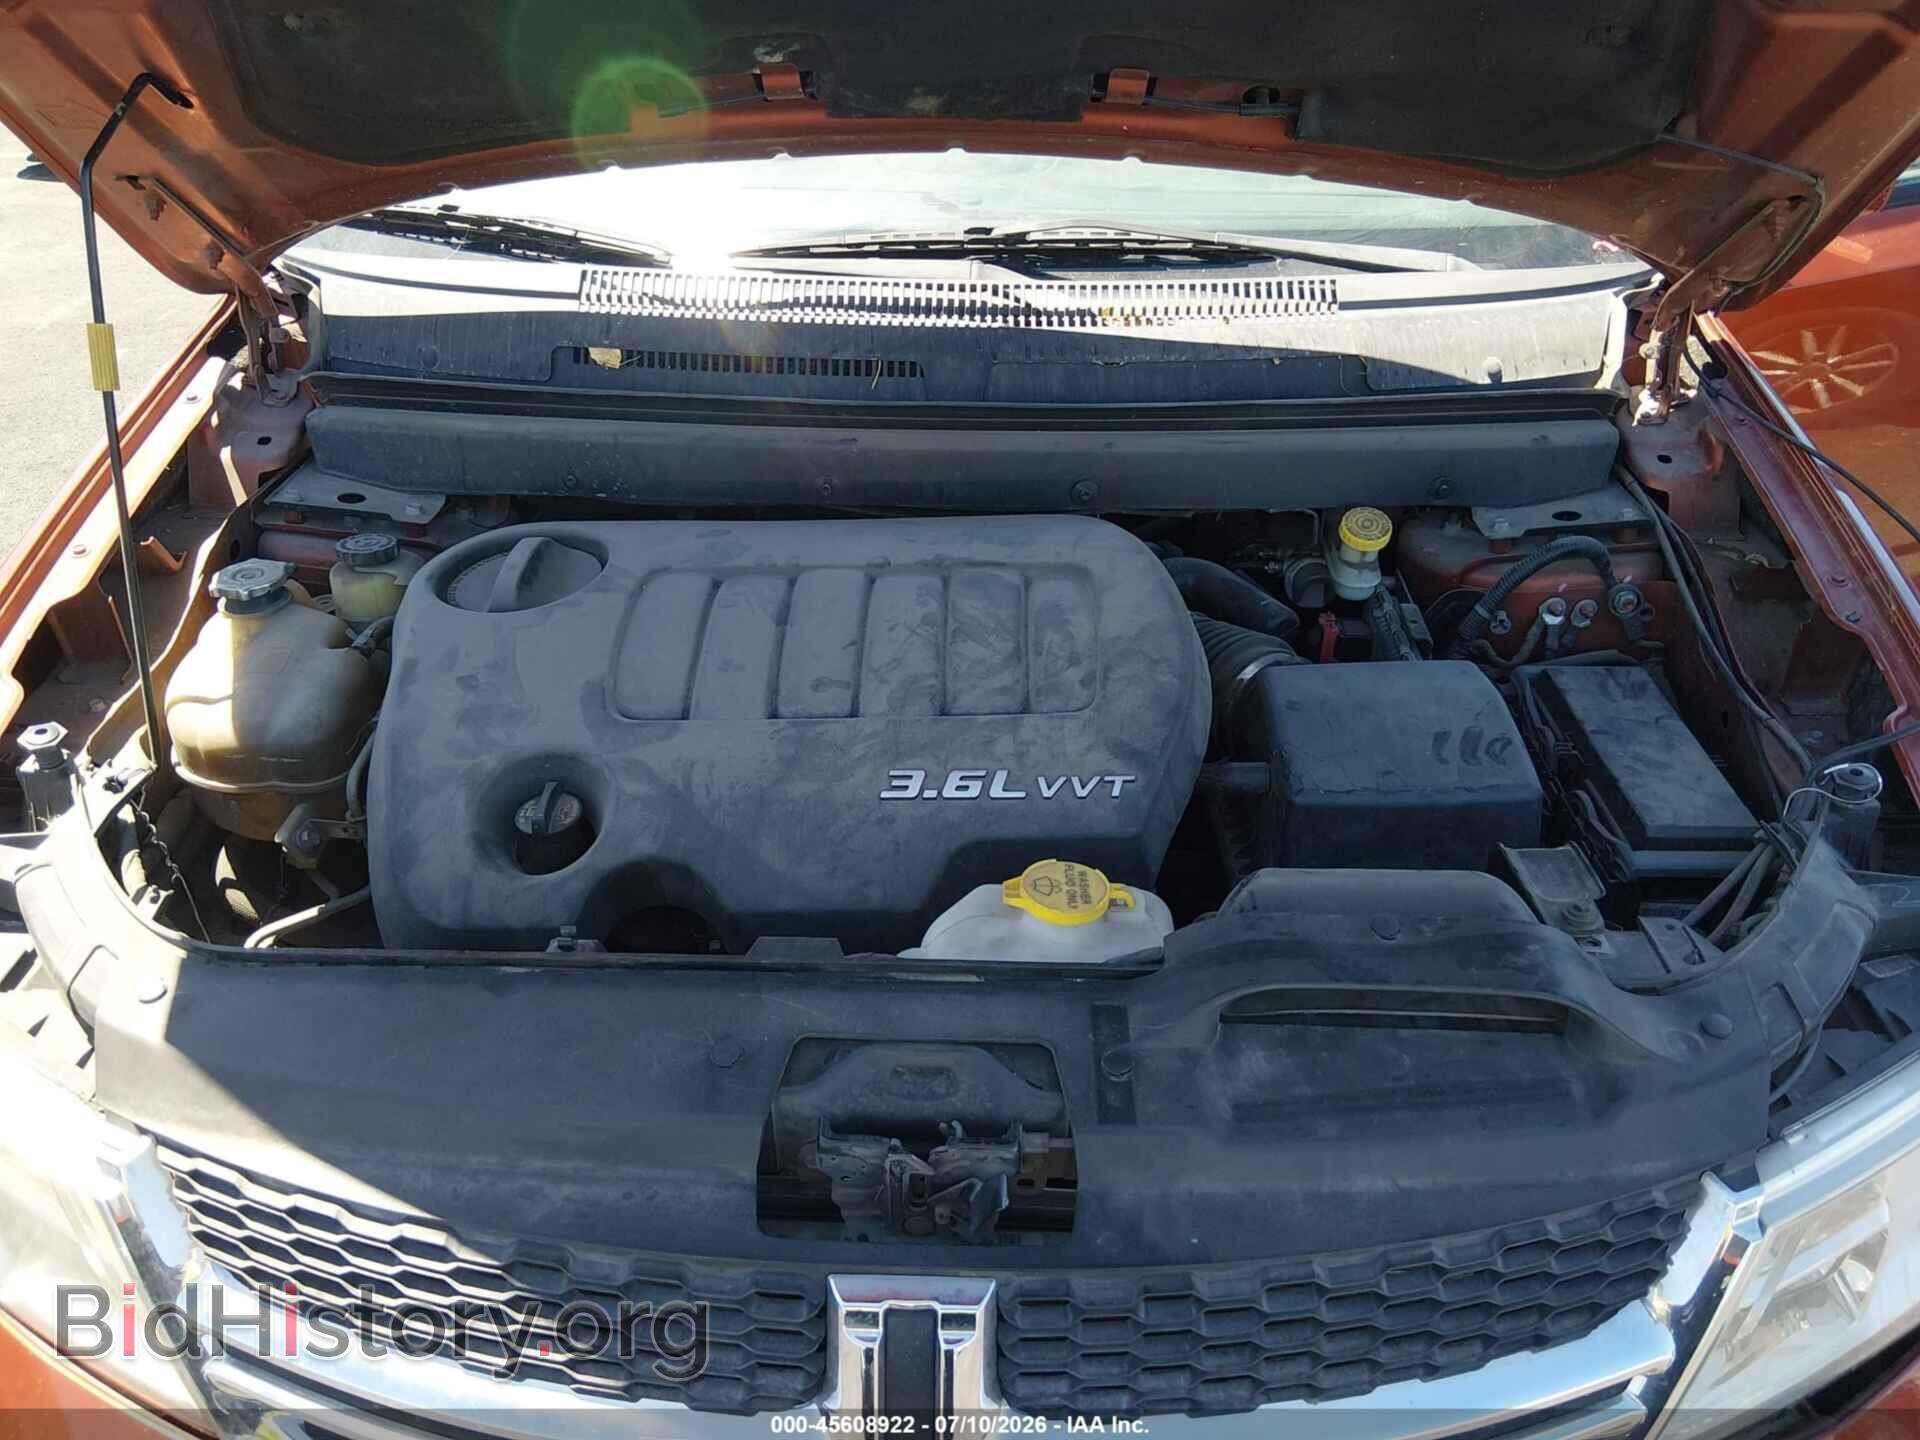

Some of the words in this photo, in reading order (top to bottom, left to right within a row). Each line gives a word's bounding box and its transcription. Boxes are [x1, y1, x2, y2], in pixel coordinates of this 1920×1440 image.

[879, 769, 1027, 800] 3.6L
[1036, 775, 1136, 799] VVT
[1064, 863, 1077, 887] FLUID
[1077, 869, 1092, 905] WASHER
[1066, 888, 1079, 909] ONLY
